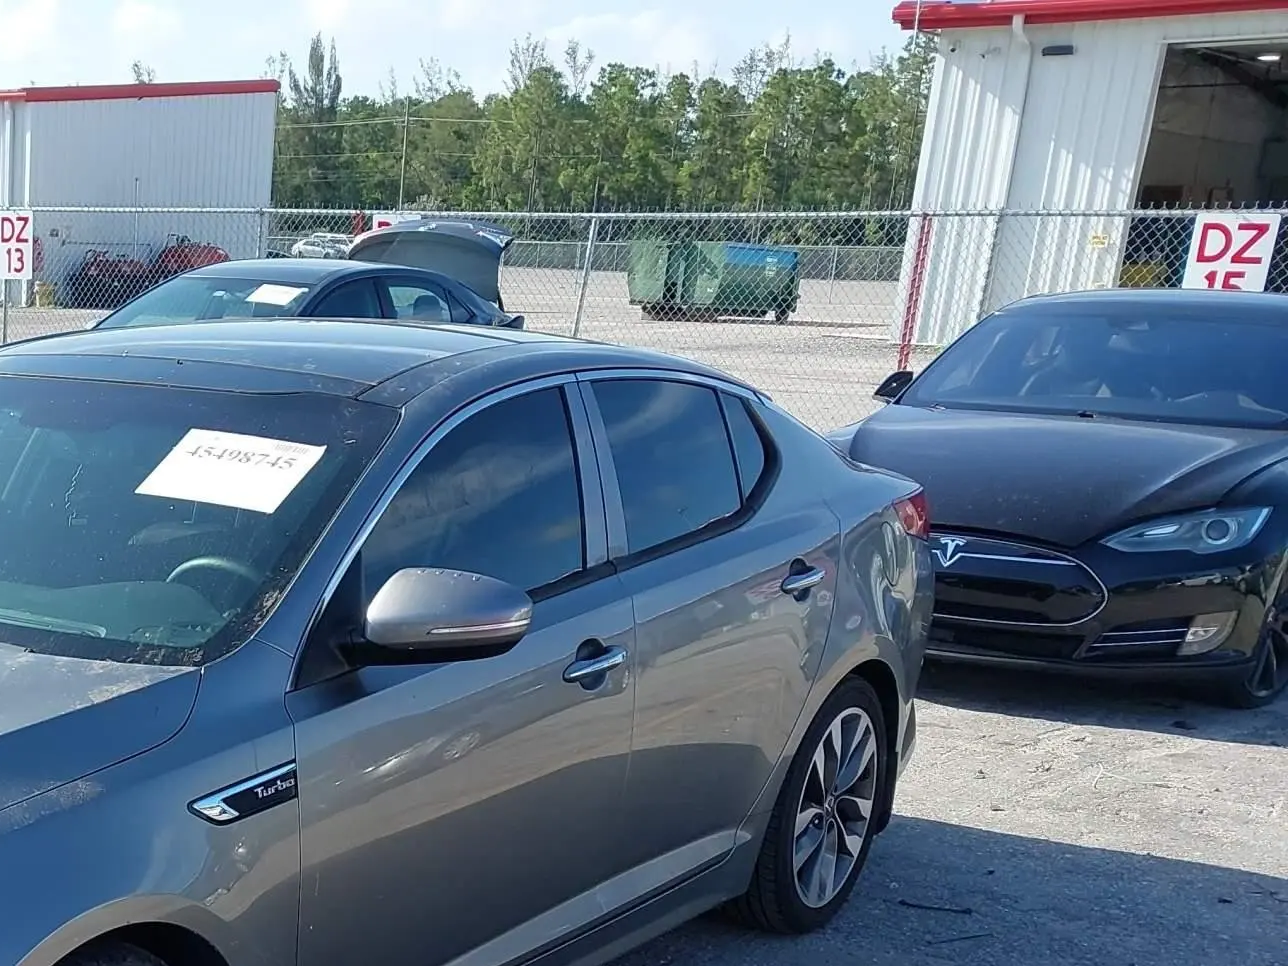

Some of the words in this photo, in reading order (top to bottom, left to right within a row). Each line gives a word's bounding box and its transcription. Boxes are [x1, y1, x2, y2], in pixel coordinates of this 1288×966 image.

[1, 216, 29, 243] DZ
[1196, 222, 1271, 264] DZ
[6, 247, 25, 273] 13
[185, 445, 298, 470] 45498745
[254, 778, 296, 799] Turbo
